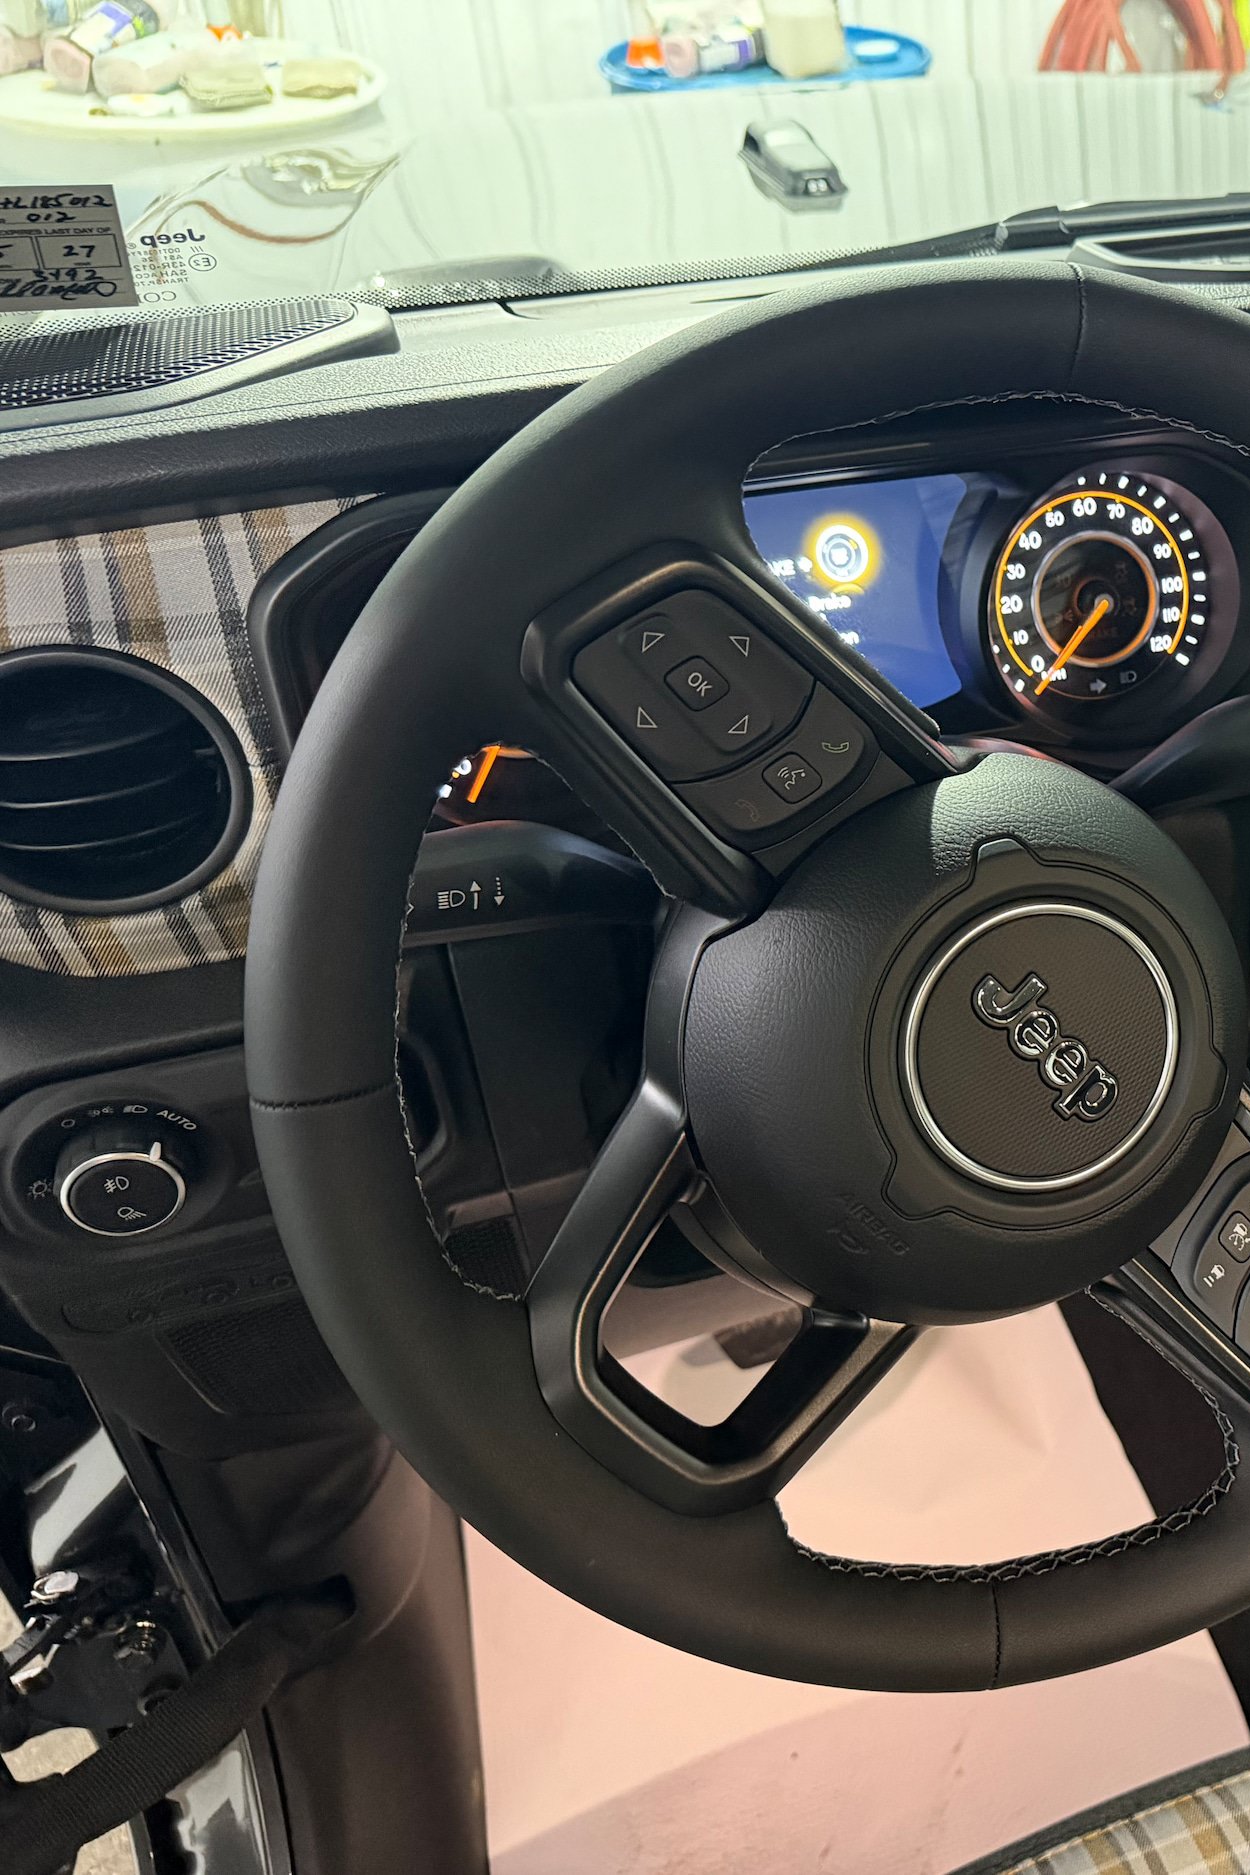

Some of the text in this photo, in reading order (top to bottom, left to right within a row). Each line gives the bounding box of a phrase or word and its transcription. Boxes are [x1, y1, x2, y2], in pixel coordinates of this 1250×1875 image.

[62, 245, 96, 258] 27
[1072, 497, 1098, 517] 60
[1106, 503, 1126, 520] 70
[1045, 510, 1065, 528] 50
[1131, 516, 1154, 536] 80
[1018, 530, 1042, 551] 40
[1153, 543, 1172, 560] 90
[1006, 562, 1026, 581] 30
[1161, 576, 1183, 594] 100
[1000, 594, 1023, 615] 20
[1162, 606, 1181, 623] 110
[1013, 629, 1029, 646] 10
[1150, 635, 1173, 653] 120
[1030, 654, 1045, 673] 0
[687, 672, 713, 697] OK
[972, 971, 1120, 1122] Jeep
[156, 1108, 198, 1131] AUTO
